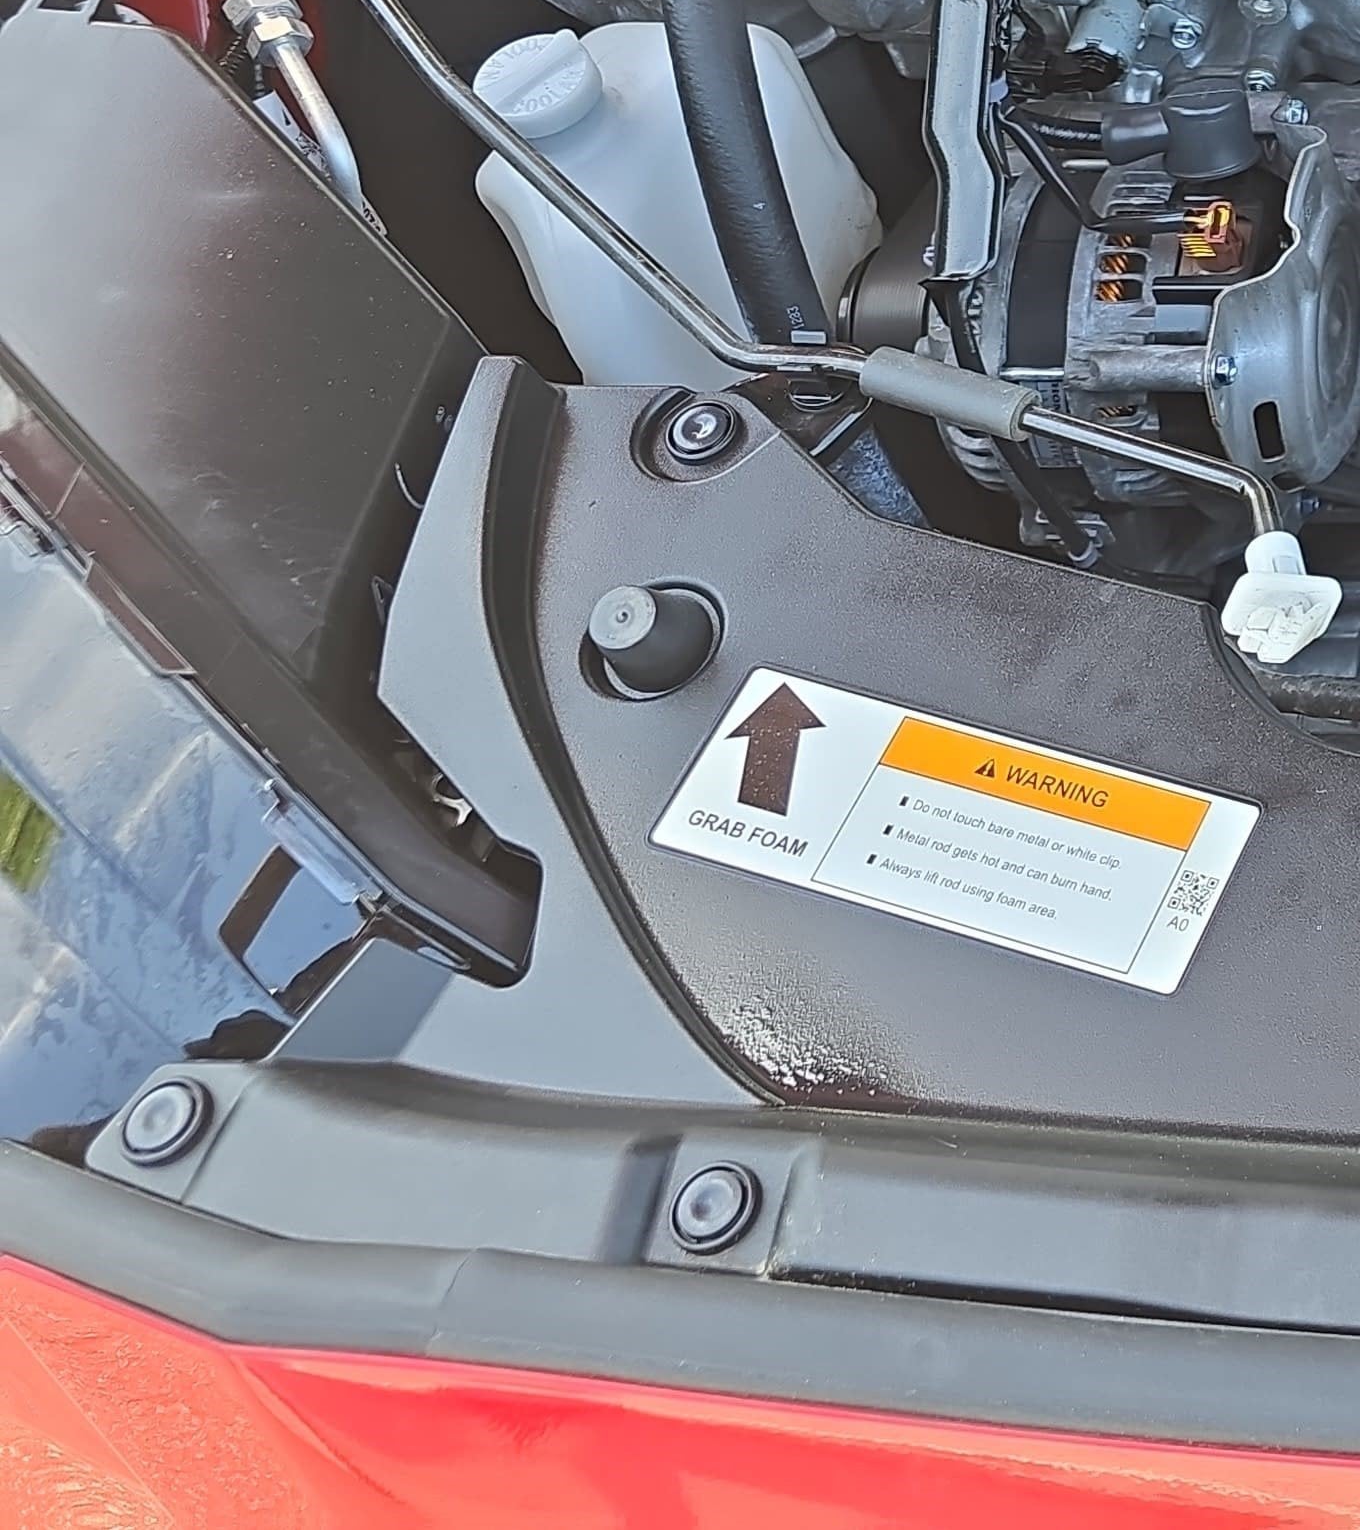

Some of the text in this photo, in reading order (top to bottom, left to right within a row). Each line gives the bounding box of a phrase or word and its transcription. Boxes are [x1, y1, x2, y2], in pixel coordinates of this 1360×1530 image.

[1006, 765, 1109, 808] WARNING
[688, 809, 809, 857] GRAB FOAM
[913, 799, 1121, 870] Do not touch bare metal or white clip.
[879, 858, 1057, 920] Always lift rod using foam area.
[896, 828, 1112, 901] Metal rod gets hot and can burn hand.
[1167, 916, 1190, 931] A0
